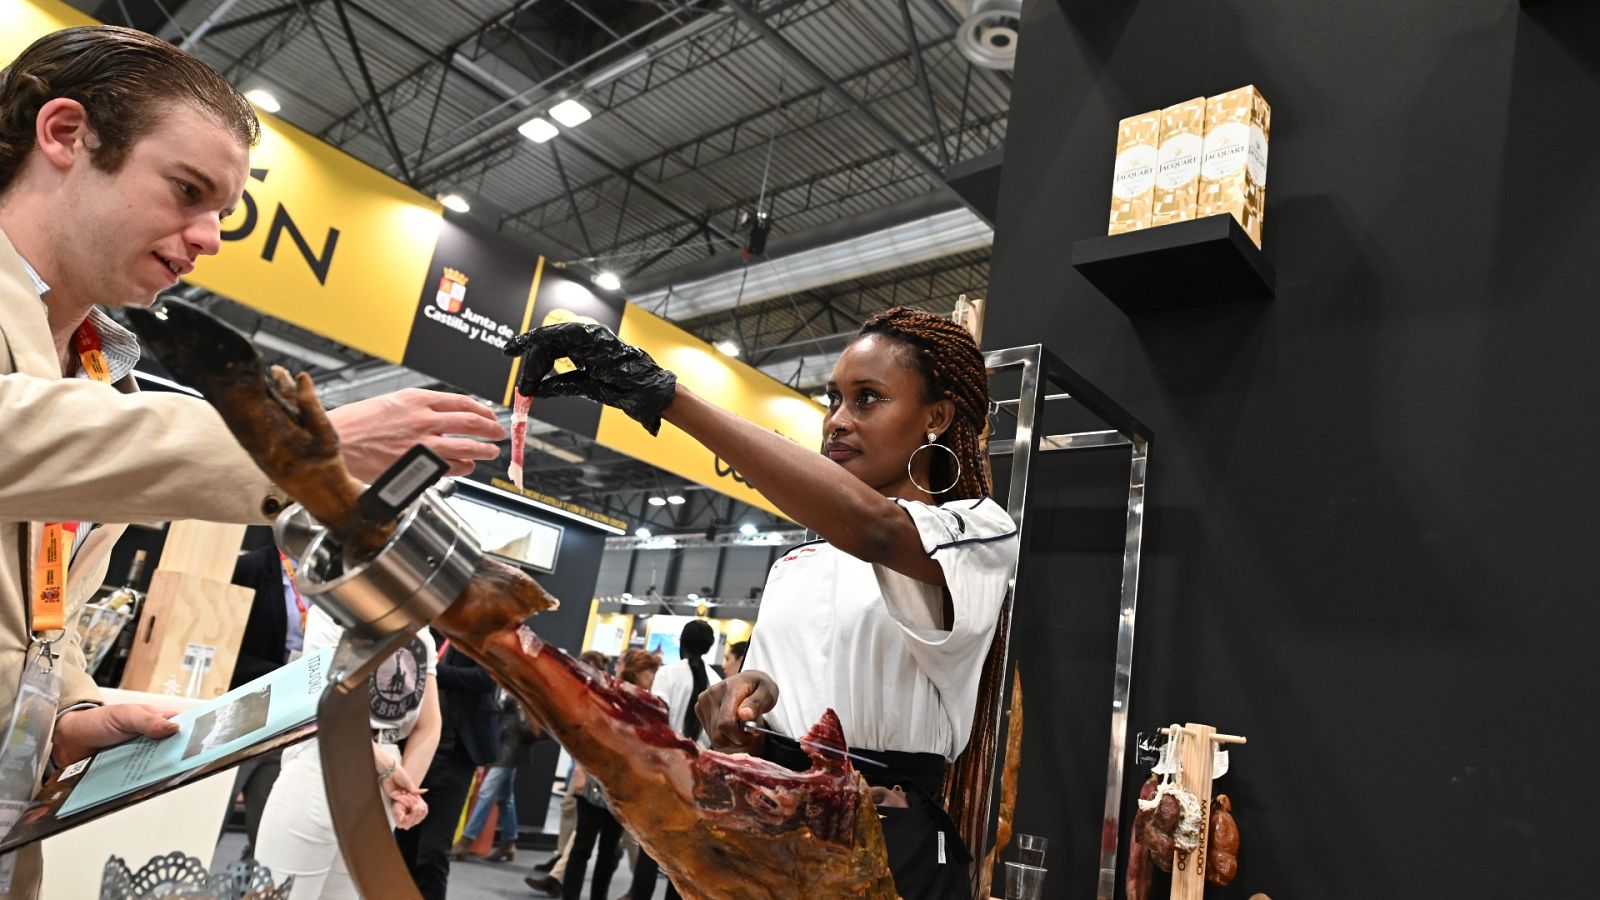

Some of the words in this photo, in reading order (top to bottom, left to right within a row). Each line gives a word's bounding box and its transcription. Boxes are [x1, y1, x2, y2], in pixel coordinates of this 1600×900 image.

[1116, 167, 1153, 182] JACQUART
[1159, 156, 1197, 173] JACQUART
[424, 305, 470, 333] Castilla
[468, 326, 480, 339] y
[461, 307, 497, 331] Junta
[497, 325, 514, 339] de
